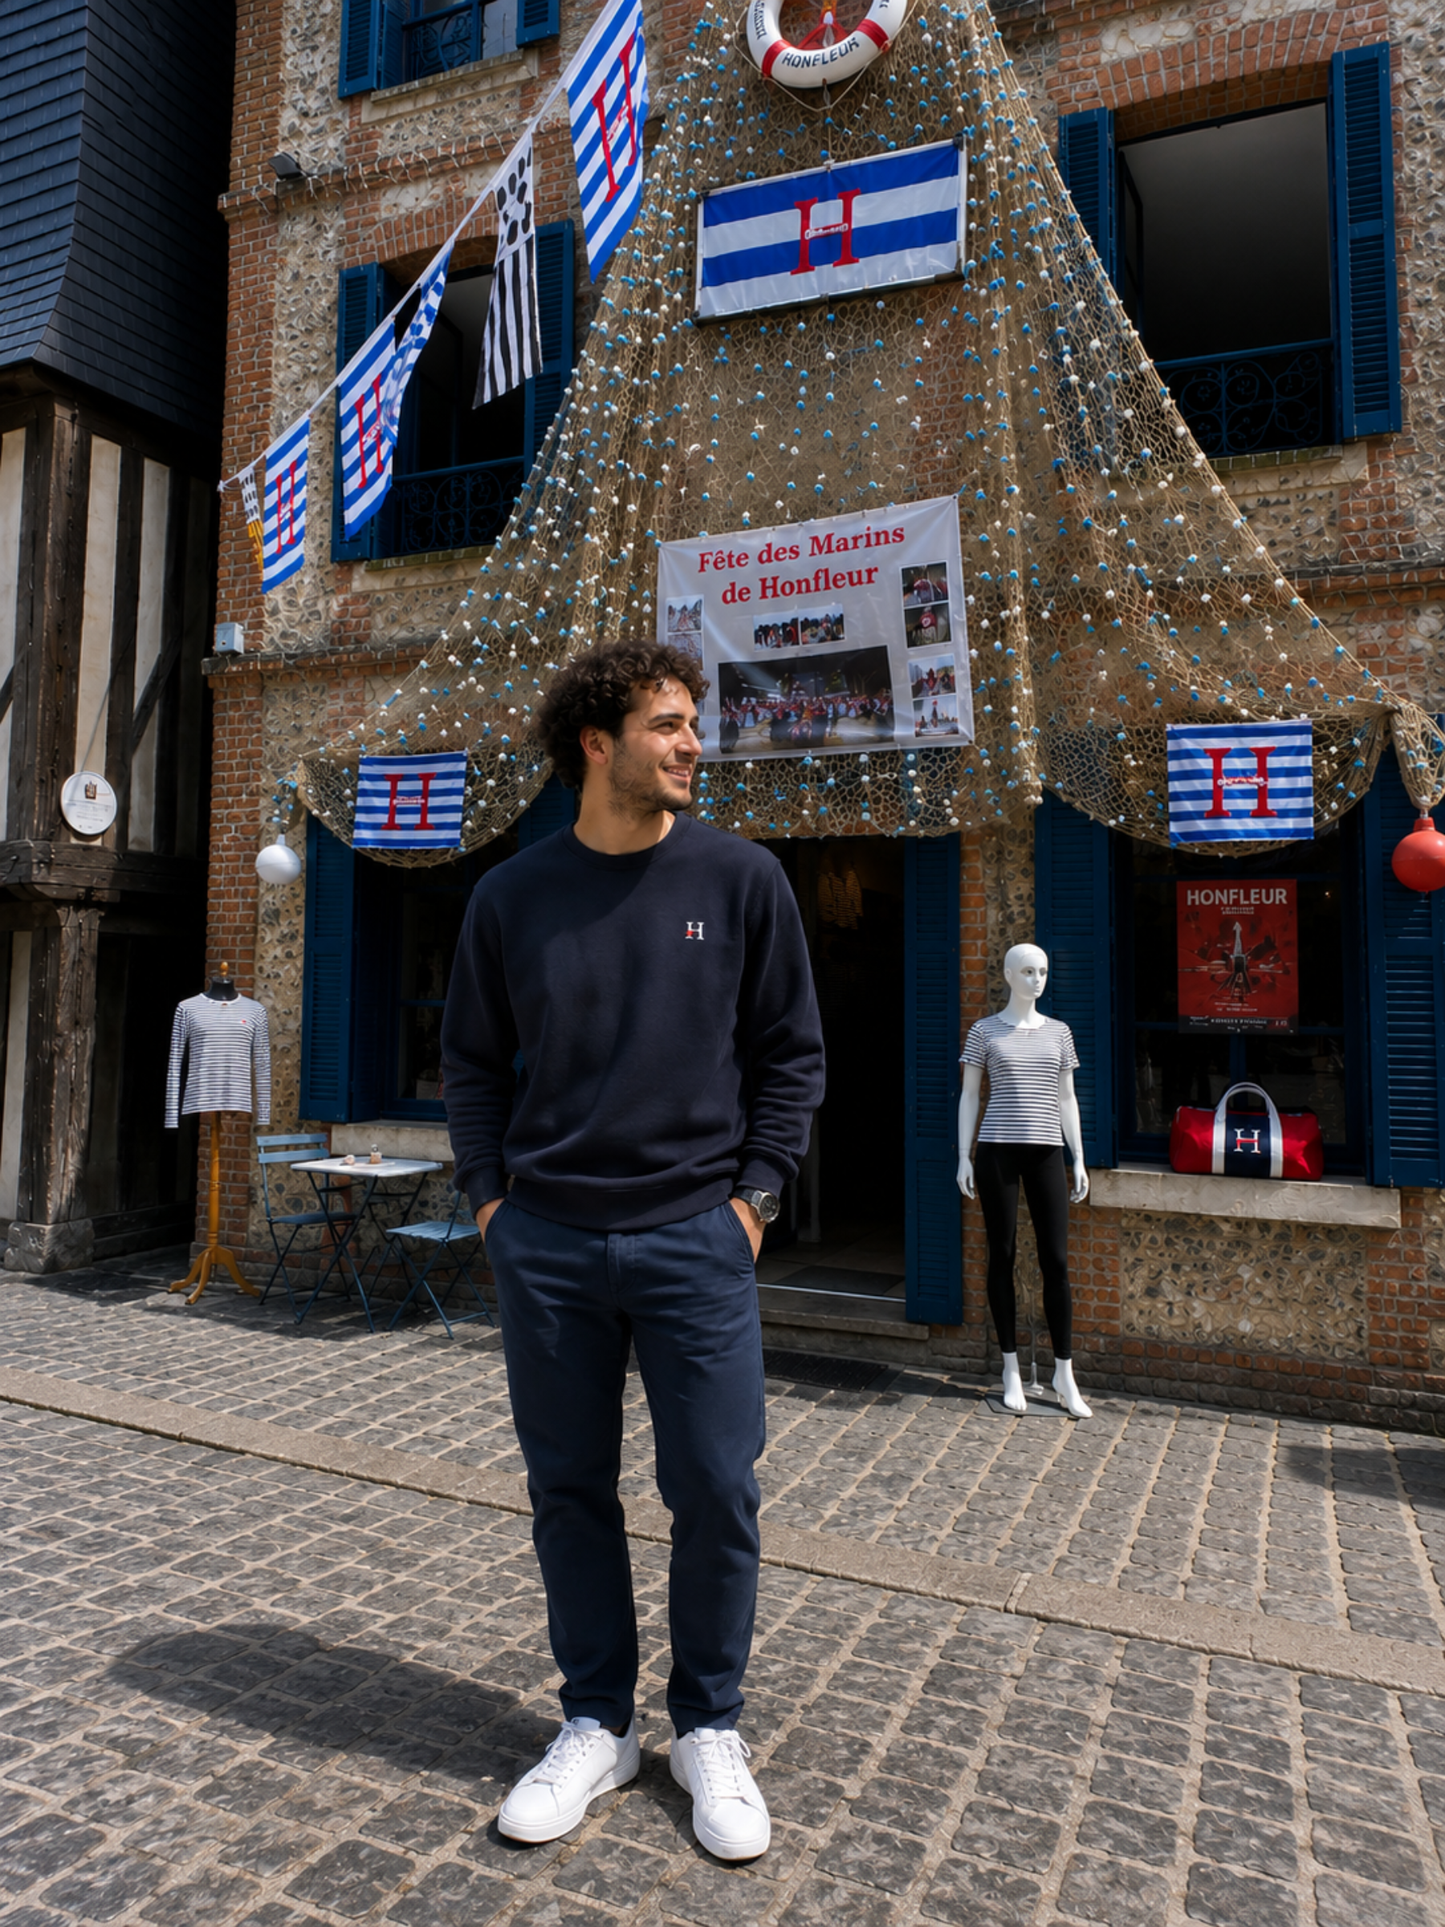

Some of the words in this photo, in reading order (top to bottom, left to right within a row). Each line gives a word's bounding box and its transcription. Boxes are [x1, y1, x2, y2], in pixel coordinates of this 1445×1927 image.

[781, 37, 860, 69] HONFLEUR
[698, 549, 750, 573] Fête
[757, 541, 801, 565] des
[808, 525, 906, 557] Marins
[721, 581, 752, 605] de
[758, 565, 880, 600] Honfleur
[1187, 888, 1289, 906] HONFLEUR
[1233, 1127, 1262, 1154] H
